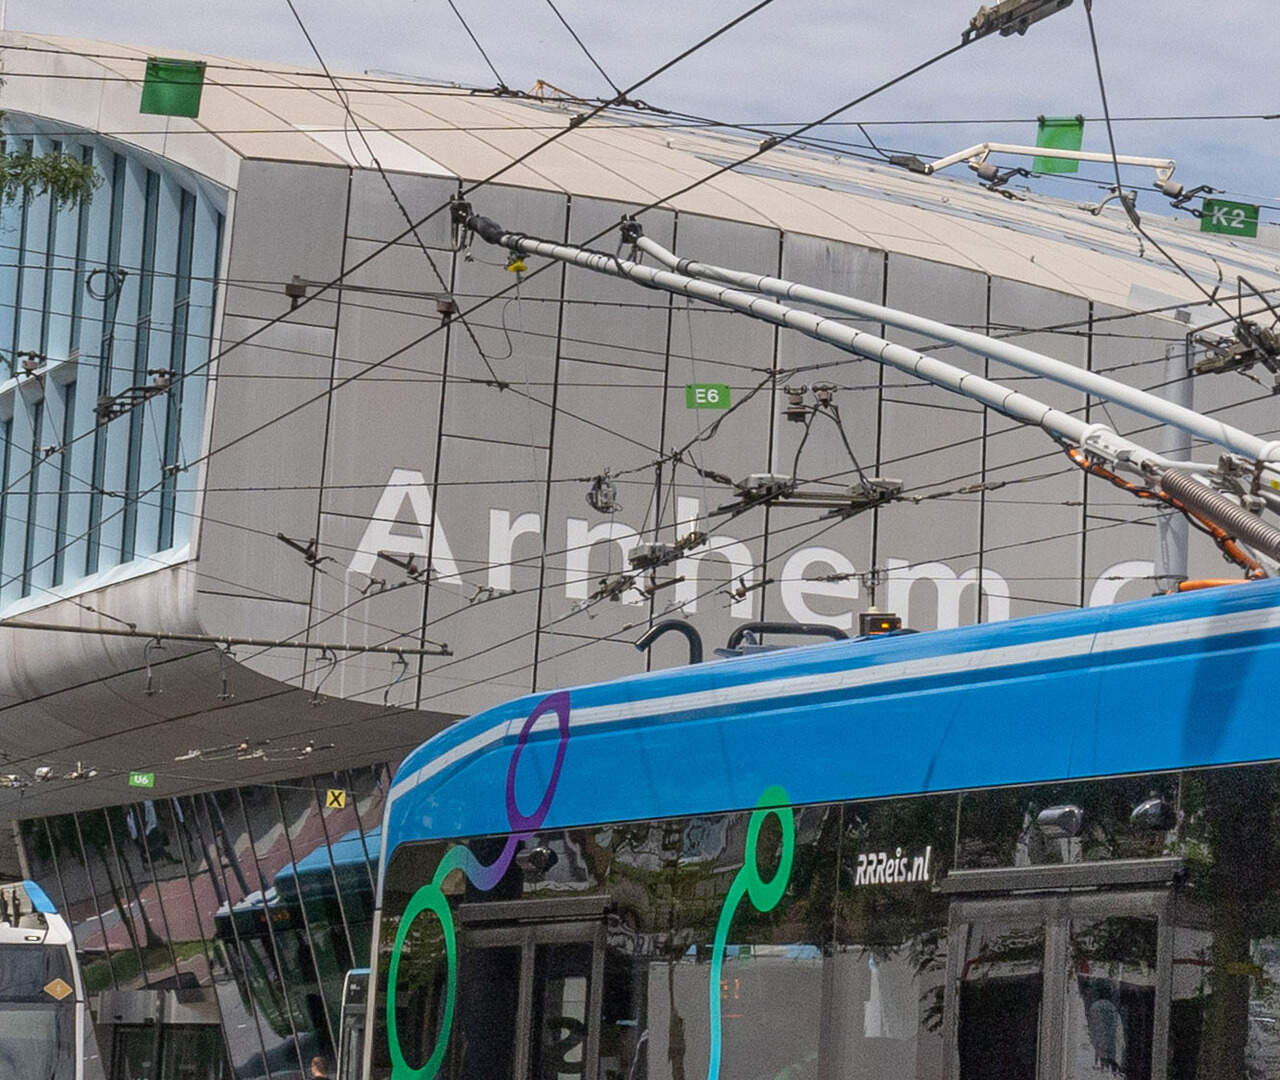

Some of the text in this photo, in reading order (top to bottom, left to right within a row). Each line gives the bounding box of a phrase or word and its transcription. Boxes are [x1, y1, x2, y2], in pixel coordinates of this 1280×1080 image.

[1212, 206, 1246, 228] K2
[695, 388, 719, 403] E6
[345, 467, 1011, 627] Arnhem
[331, 791, 342, 807] X
[855, 845, 932, 886] RRReis.nl
